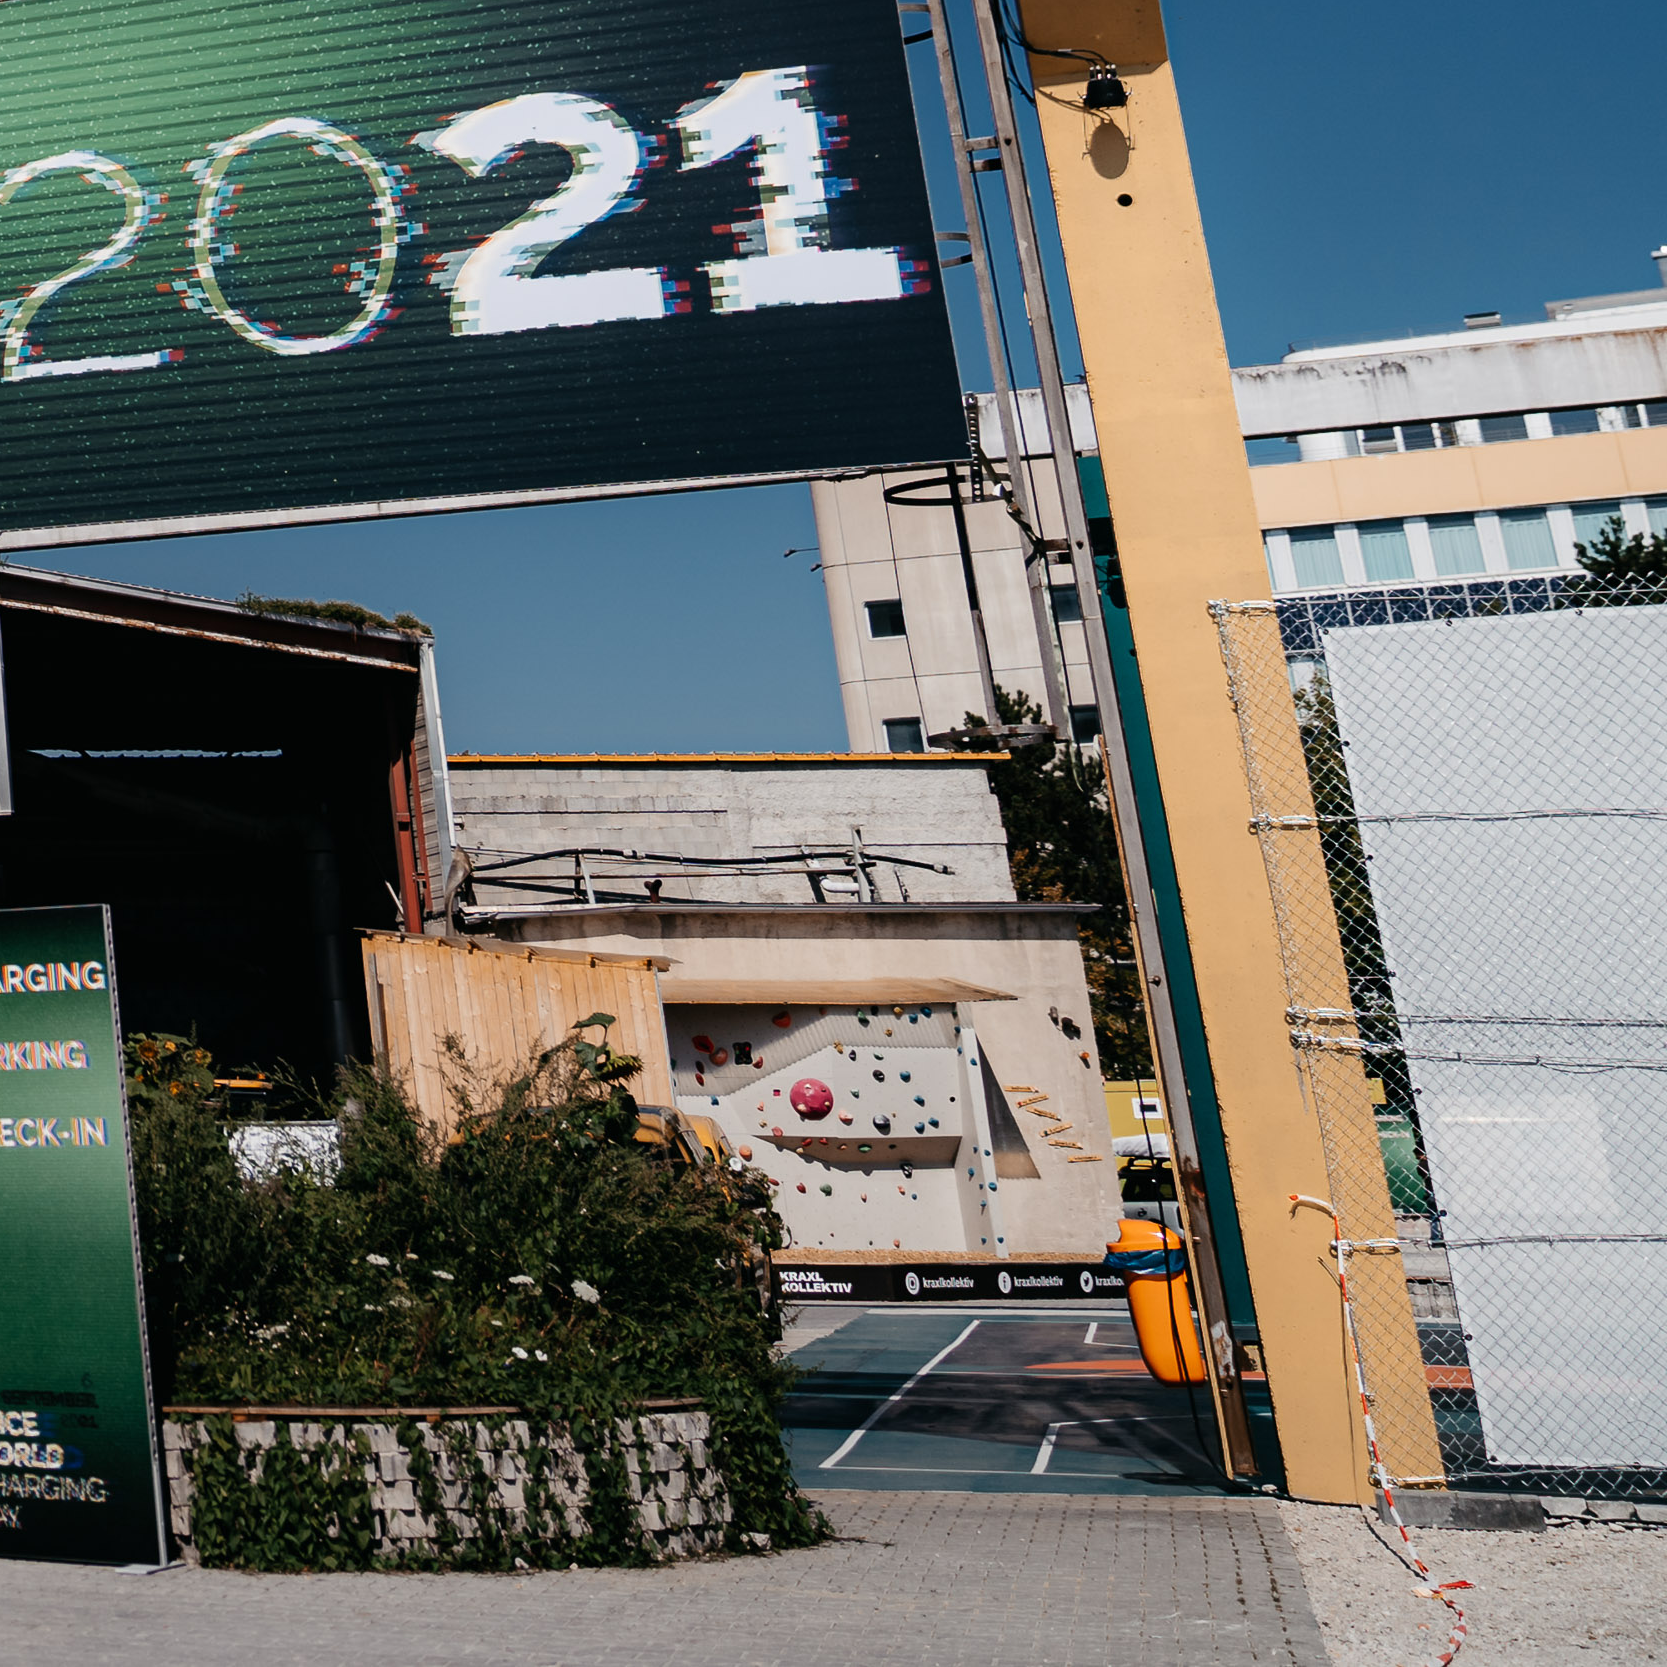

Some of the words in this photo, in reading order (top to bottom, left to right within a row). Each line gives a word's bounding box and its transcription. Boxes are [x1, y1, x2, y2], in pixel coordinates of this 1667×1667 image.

[779, 1271, 824, 1282] KRAXL
[1014, 1276, 1063, 1287] kraxlkollektiv
[781, 1282, 852, 1293] KOLLEKTIV
[922, 1277, 974, 1288] kraxlkollektiv
